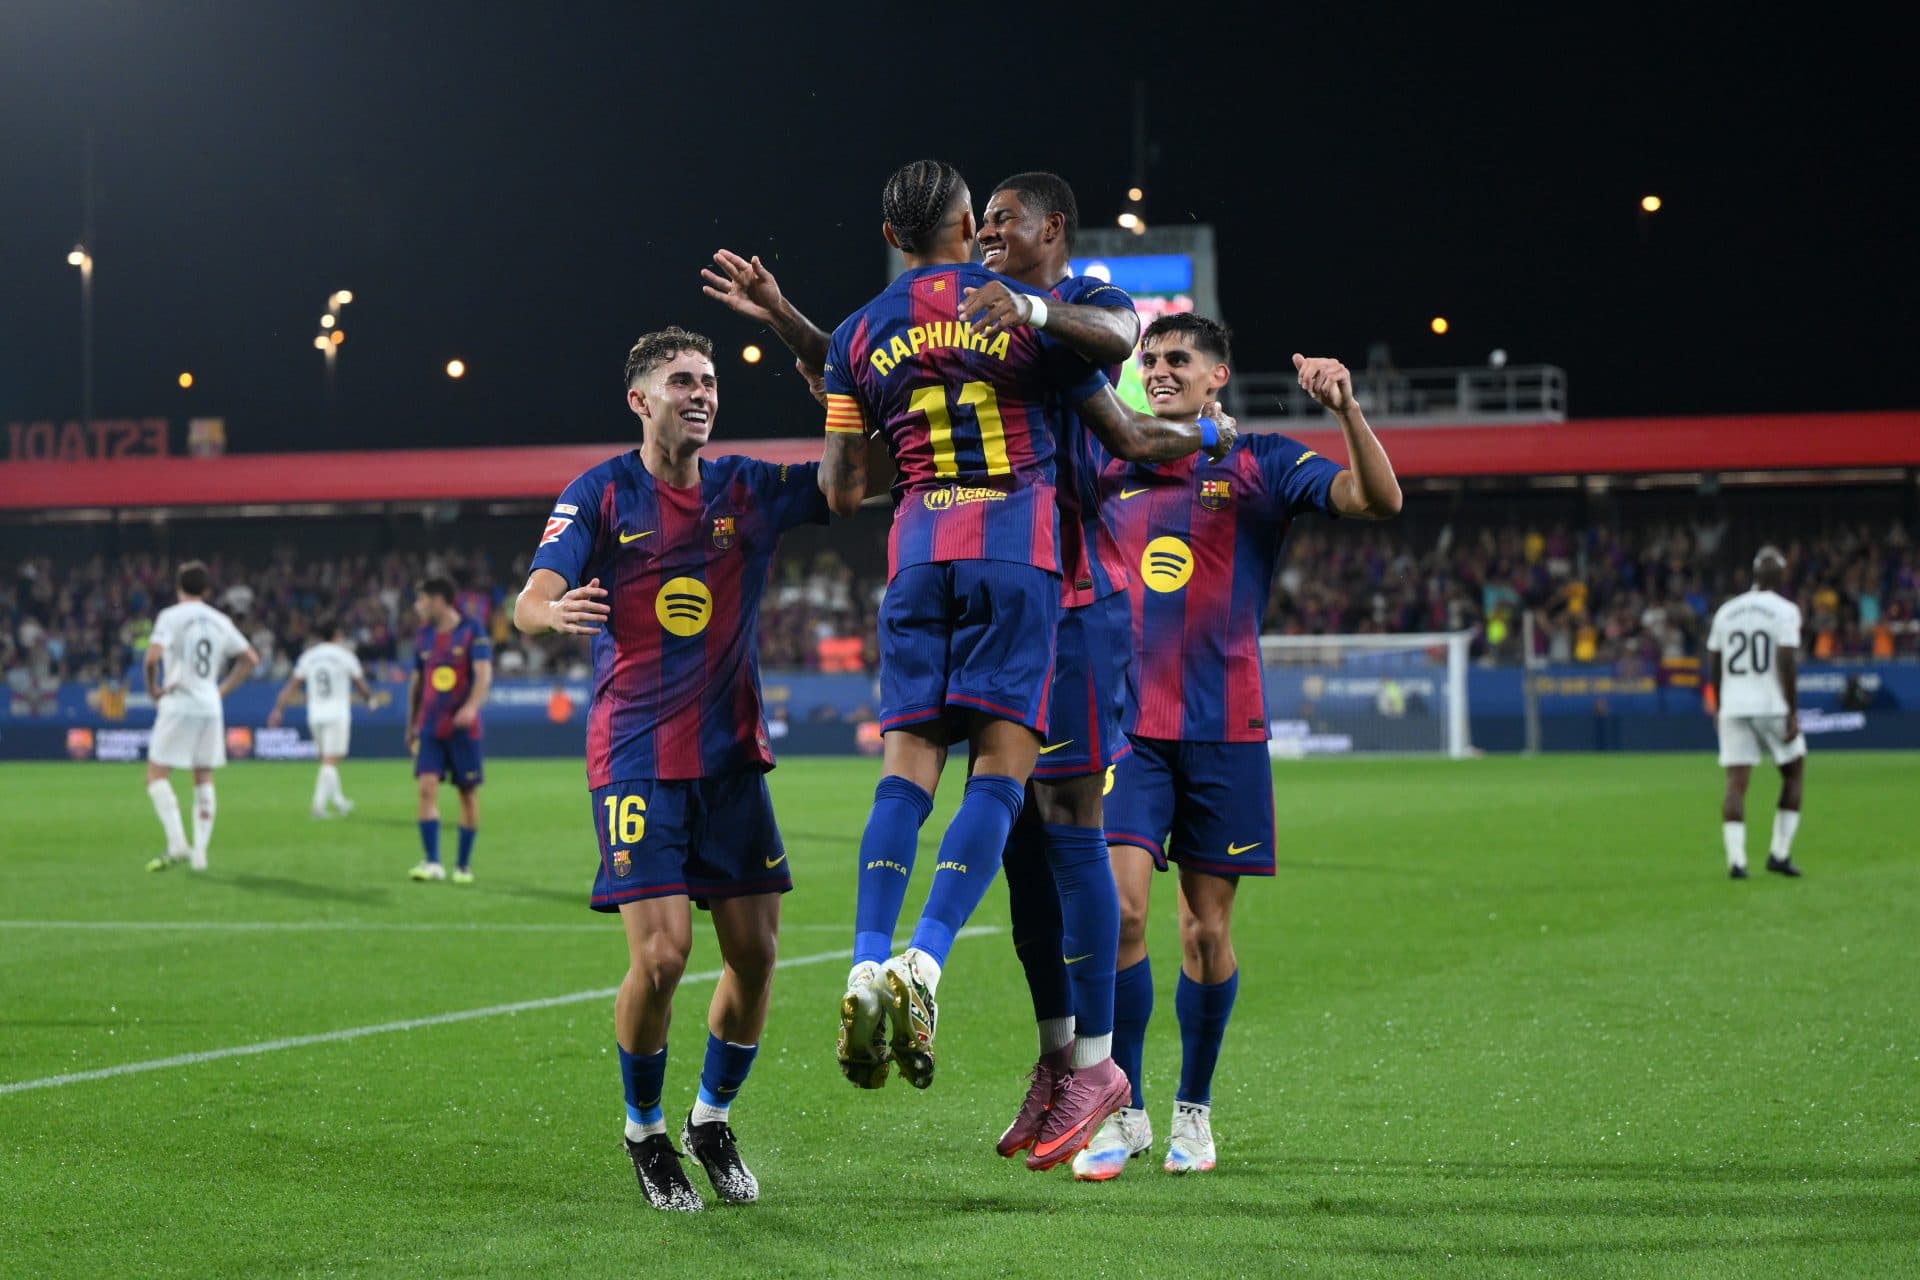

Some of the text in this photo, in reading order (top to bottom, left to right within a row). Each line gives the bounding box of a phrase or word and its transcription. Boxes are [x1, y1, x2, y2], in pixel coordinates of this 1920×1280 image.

[870, 320, 1011, 376] RAPHINHA
[907, 381, 1011, 478] 11
[195, 637, 213, 678] 8
[1728, 630, 1771, 675] 20
[604, 795, 647, 845] 16
